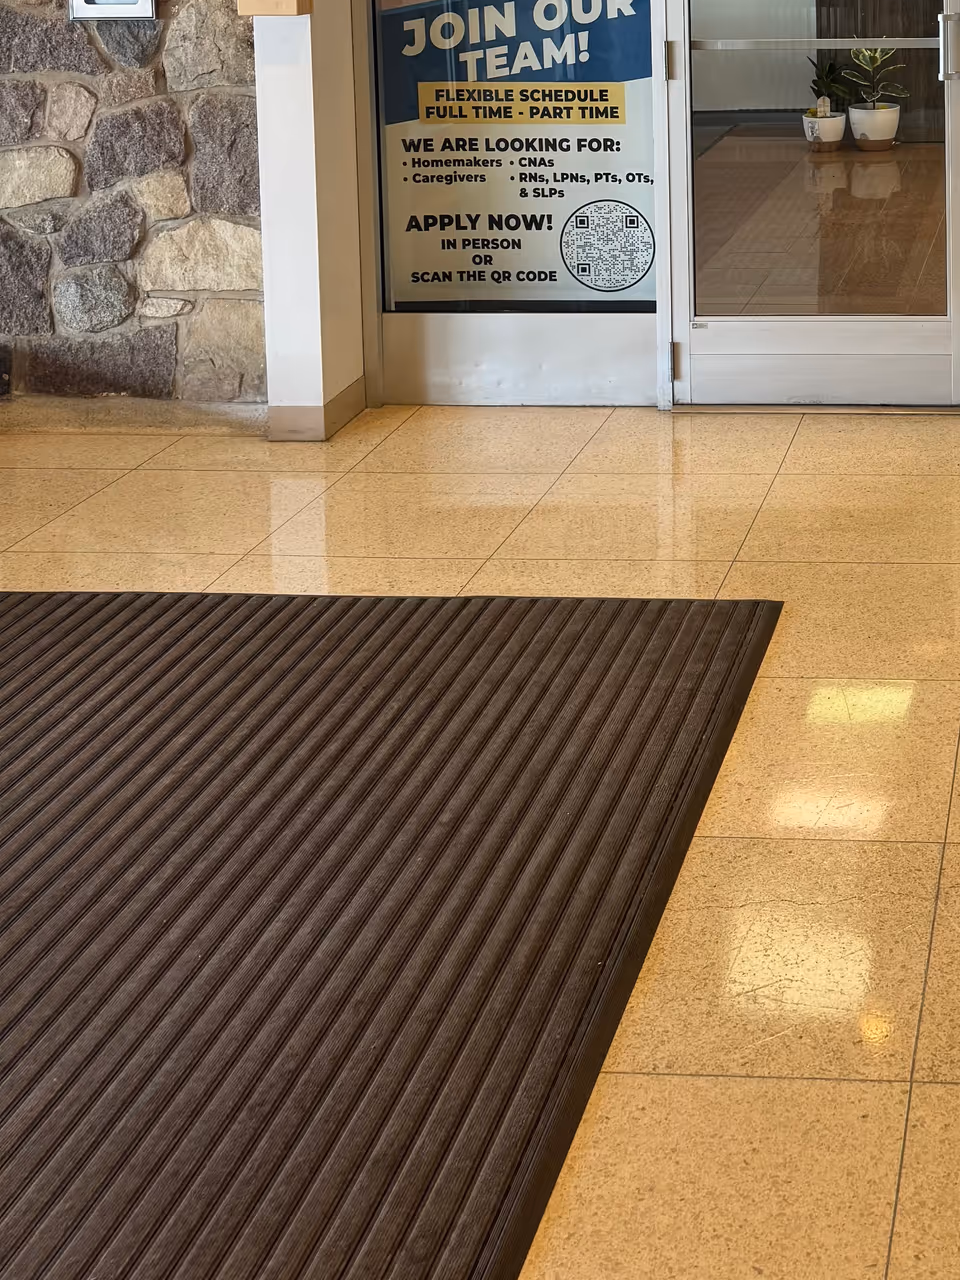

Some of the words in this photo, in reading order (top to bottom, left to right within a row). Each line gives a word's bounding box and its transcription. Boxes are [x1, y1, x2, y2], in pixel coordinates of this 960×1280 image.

[401, 0, 517, 57] JOIN
[458, 30, 590, 82] TEAM!
[435, 88, 514, 102] FLEXIBLE
[519, 88, 609, 102] SCHEDULE
[425, 105, 468, 119] FULL
[471, 105, 513, 119] TIME
[529, 106, 573, 119] PART
[580, 106, 620, 119] TIME
[401, 138, 435, 153] WE
[440, 137, 479, 152] ARE
[485, 137, 571, 153] LOOKING
[577, 137, 621, 152] FOR:
[412, 156, 503, 168] Homemakers
[518, 156, 555, 168] CNAs
[412, 170, 487, 185] Caregivers
[519, 172, 549, 185] RNs,
[553, 172, 590, 185] LPNs,
[594, 172, 622, 185] PTs,
[625, 172, 654, 185] OTs,
[519, 187, 529, 198] &
[532, 187, 565, 199] SLPs
[405, 214, 481, 232] APPLY
[487, 213, 554, 231] NOW!
[441, 238, 457, 250] IN
[461, 238, 522, 250] PERSON
[471, 254, 494, 266] OR
[410, 271, 453, 283] SCAN
[456, 270, 486, 282] THE
[490, 270, 512, 284] QR
[516, 270, 558, 282] CODE
